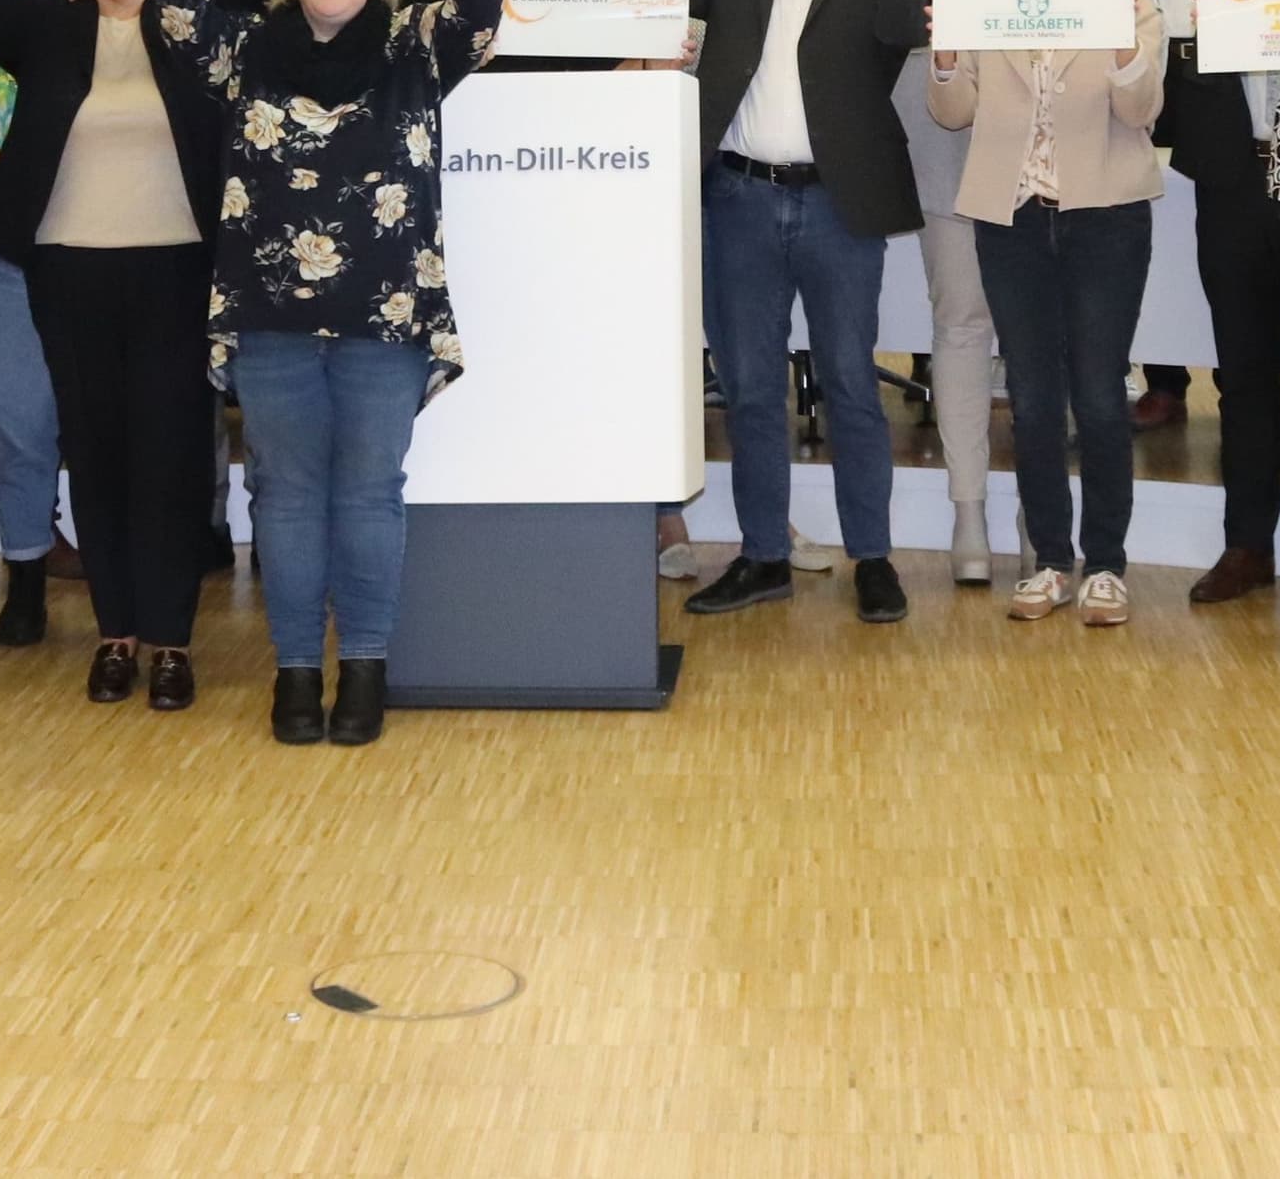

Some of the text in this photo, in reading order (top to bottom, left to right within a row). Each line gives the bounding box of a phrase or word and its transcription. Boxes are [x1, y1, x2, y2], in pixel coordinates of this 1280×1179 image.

[984, 18, 1083, 30] ST. ELISABETH
[441, 145, 650, 173] ahn-Dill-Kreis
